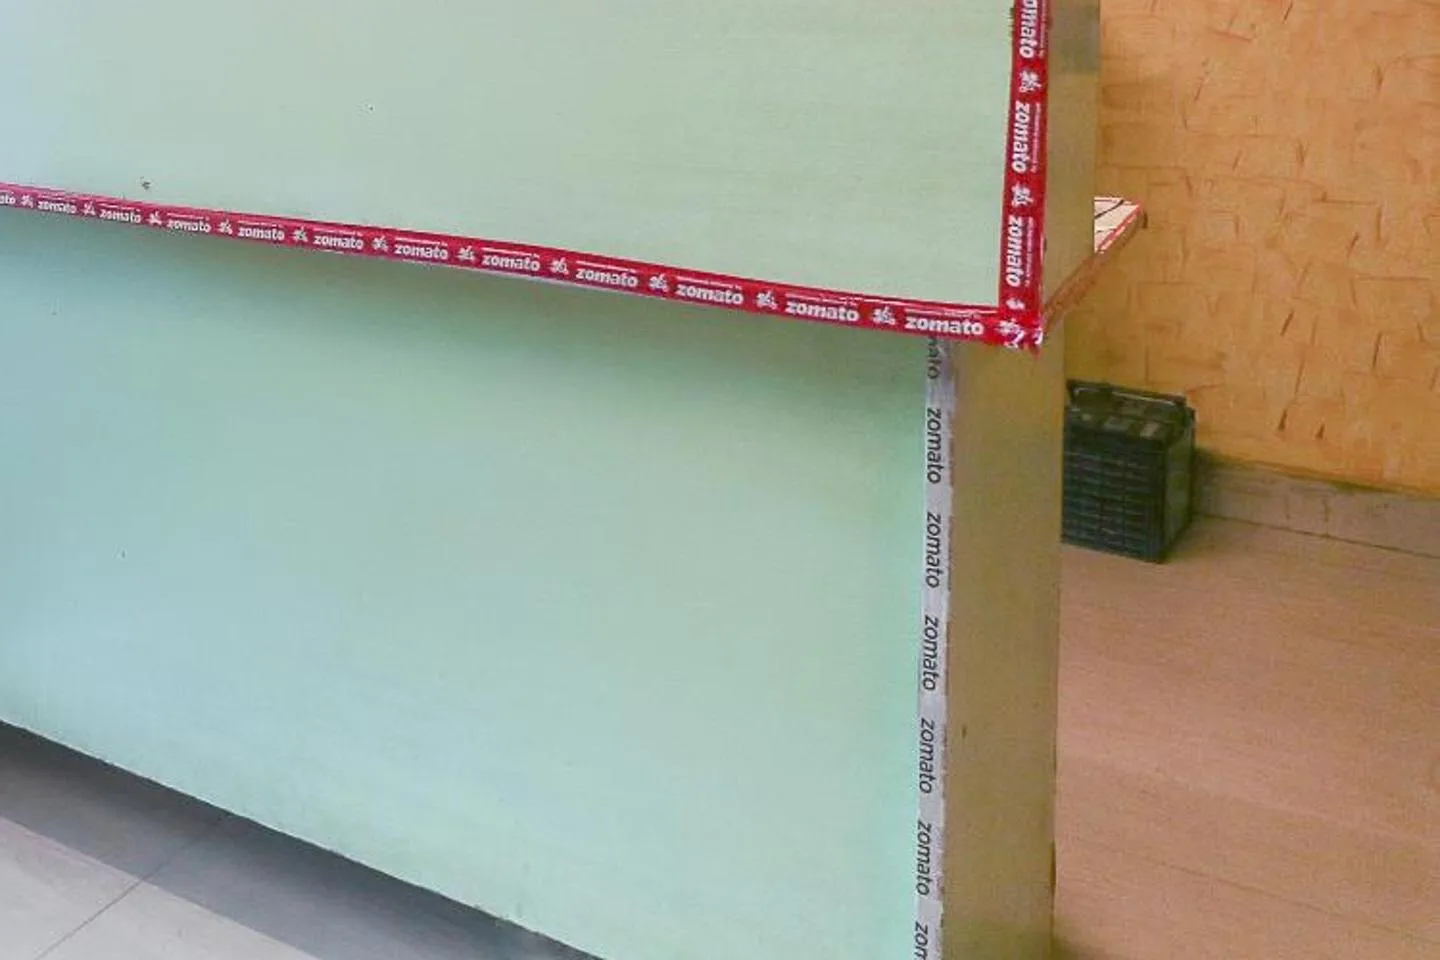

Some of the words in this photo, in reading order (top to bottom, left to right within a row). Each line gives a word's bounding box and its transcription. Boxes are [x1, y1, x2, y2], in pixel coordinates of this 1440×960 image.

[1012, 100, 1030, 173] zomato
[37, 199, 77, 214] zomato
[99, 209, 142, 224] zomato
[166, 218, 211, 233] zomato
[237, 226, 285, 241] zomato
[313, 233, 364, 250] zomato
[393, 242, 448, 260] zomato
[481, 253, 541, 272] zomato
[575, 268, 639, 288] zomato
[675, 281, 744, 306] zomato
[785, 299, 860, 323] zomato
[904, 314, 984, 336] zomato
[1006, 215, 1023, 287] zomato
[926, 407, 944, 485] zomato
[925, 511, 943, 589] zomato
[922, 615, 939, 692] zomato
[919, 718, 937, 795] zomato
[915, 820, 933, 896] zomato
[913, 921, 929, 960] zom
